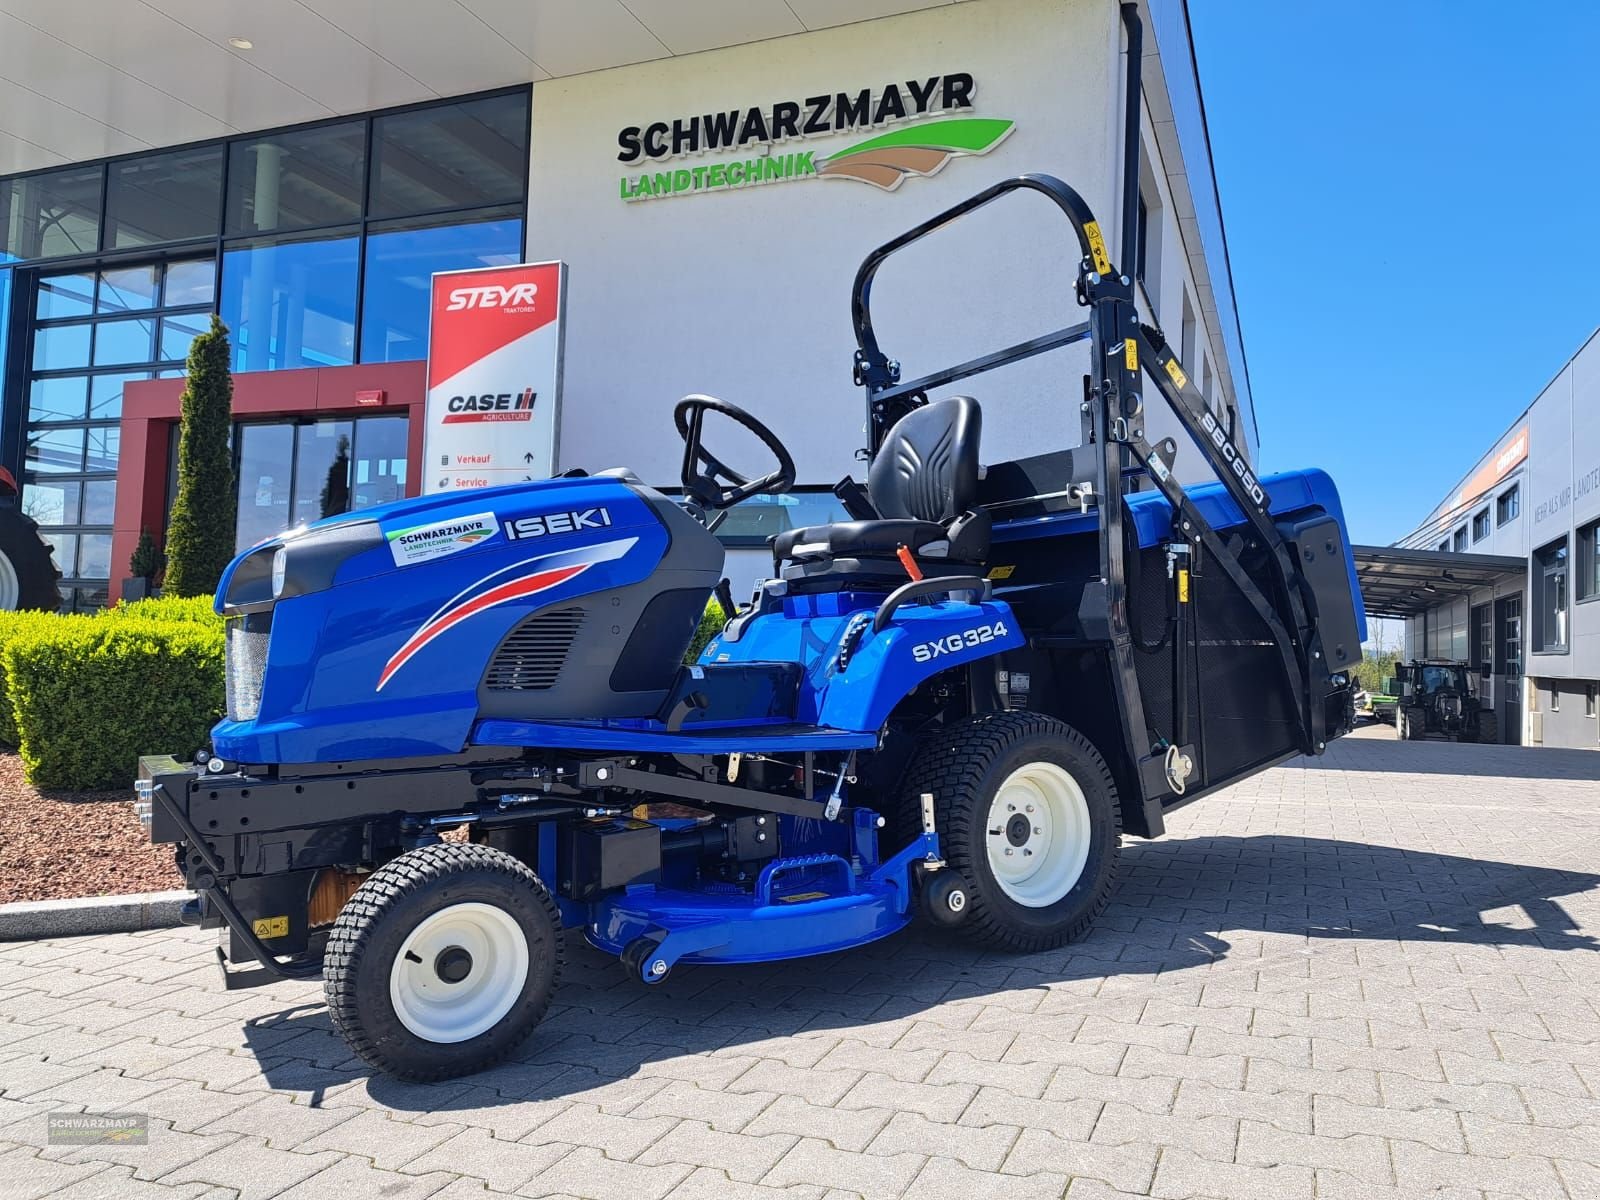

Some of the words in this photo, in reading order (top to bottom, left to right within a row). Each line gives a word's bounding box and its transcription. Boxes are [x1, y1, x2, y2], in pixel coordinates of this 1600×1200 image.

[617, 73, 974, 162] SCHWARZMAYR
[620, 151, 817, 199] LANDTECHNIK
[447, 283, 538, 312] STEYR
[503, 306, 536, 314] TRAKTOREN
[448, 393, 511, 412] CASE
[482, 412, 530, 421] AGRICULTURE
[456, 454, 491, 464] Verkauf
[1202, 412, 1265, 504] SBC650
[455, 477, 488, 487] Service
[400, 522, 483, 545] SCHWARZMAYR
[504, 507, 612, 541] ISEKI
[404, 538, 454, 552] LANDTECHNIK
[912, 621, 1008, 663] SXG324
